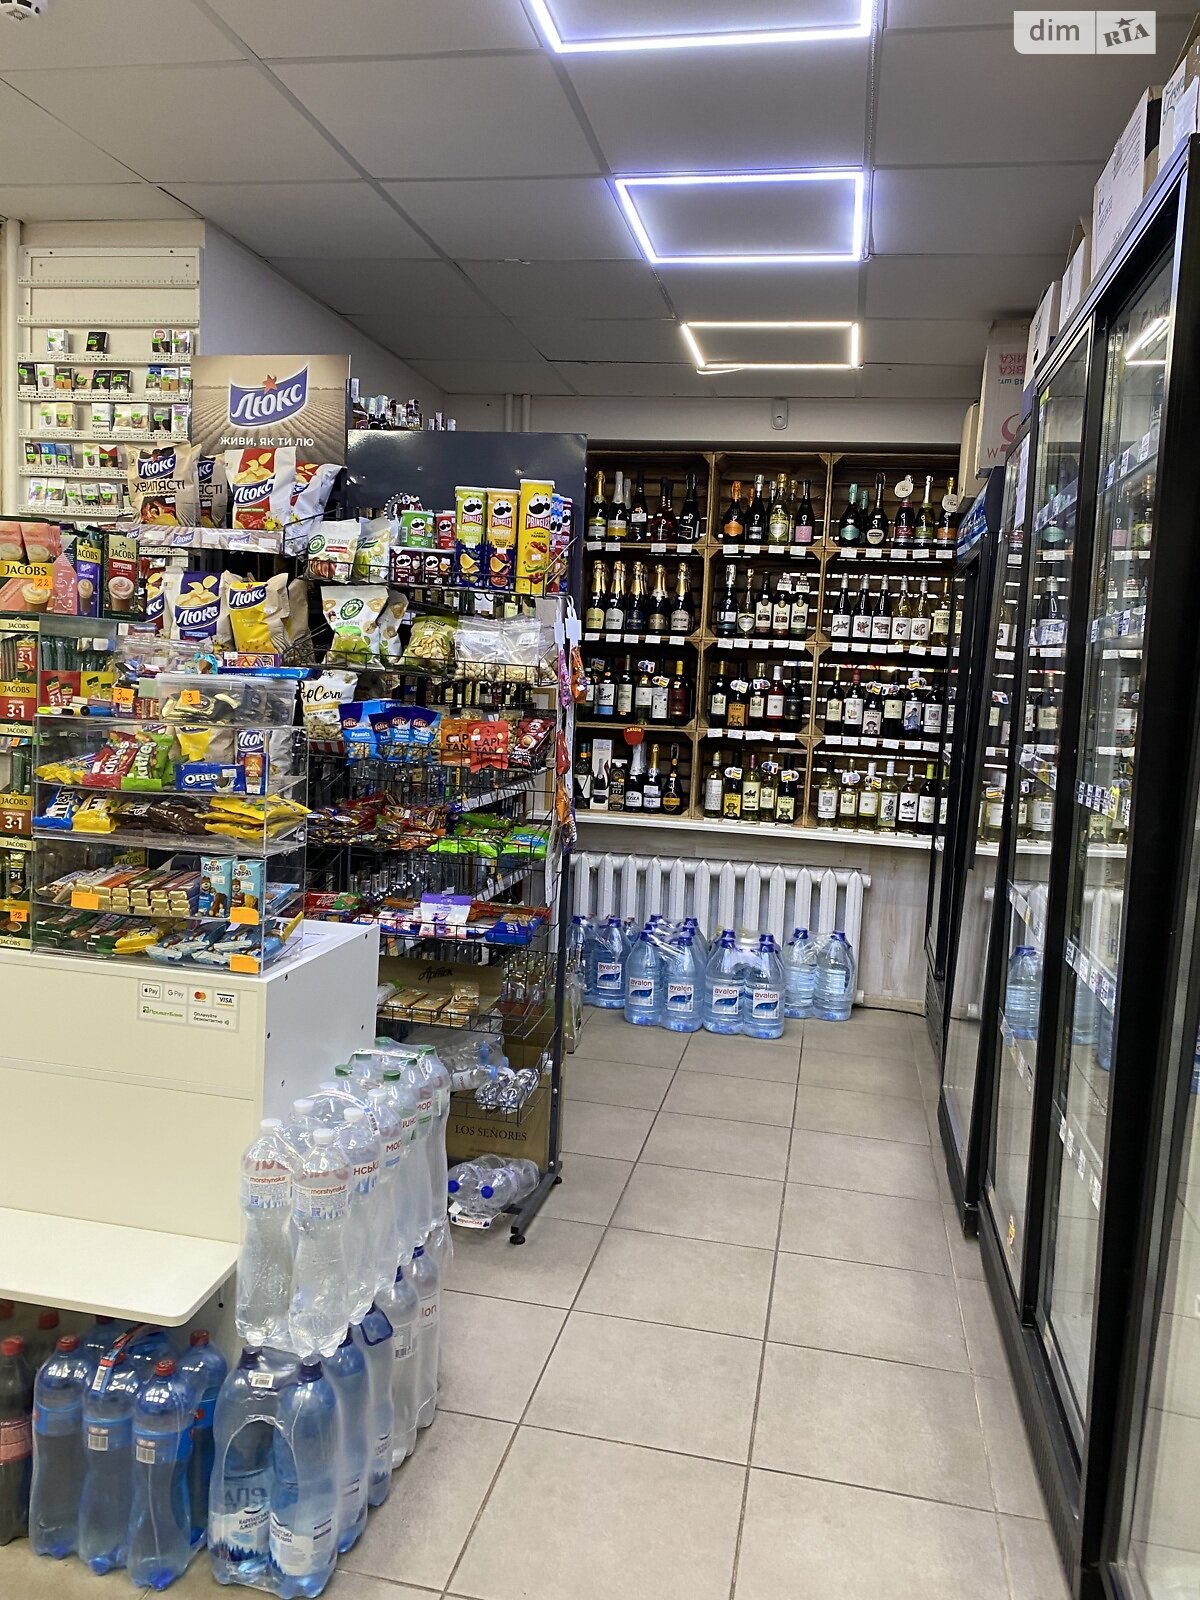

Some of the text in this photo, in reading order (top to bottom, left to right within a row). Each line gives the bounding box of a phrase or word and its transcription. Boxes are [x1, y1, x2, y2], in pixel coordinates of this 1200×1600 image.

[220, 437, 256, 447] ЖИВИ,
[259, 438, 274, 446] ЯК
[277, 438, 292, 446] ТИ
[133, 480, 185, 493] ХВИЛЯСТІ
[111, 549, 135, 560] JACOBS
[5, 564, 47, 576] JACOBS
[4, 684, 30, 693] JACOBS
[6, 727, 28, 735] JACOBS
[184, 773, 218, 785] OREO
[0, 797, 28, 806] JACOBS
[598, 963, 620, 972] avalon
[630, 979, 652, 987] avalon
[669, 984, 693, 993] avalon
[714, 987, 738, 995] avalon
[755, 992, 778, 1000] avalon
[455, 1124, 527, 1141] LOS SEÑORES
[250, 1176, 285, 1184] morshynska
[311, 1185, 346, 1194] morshynska
